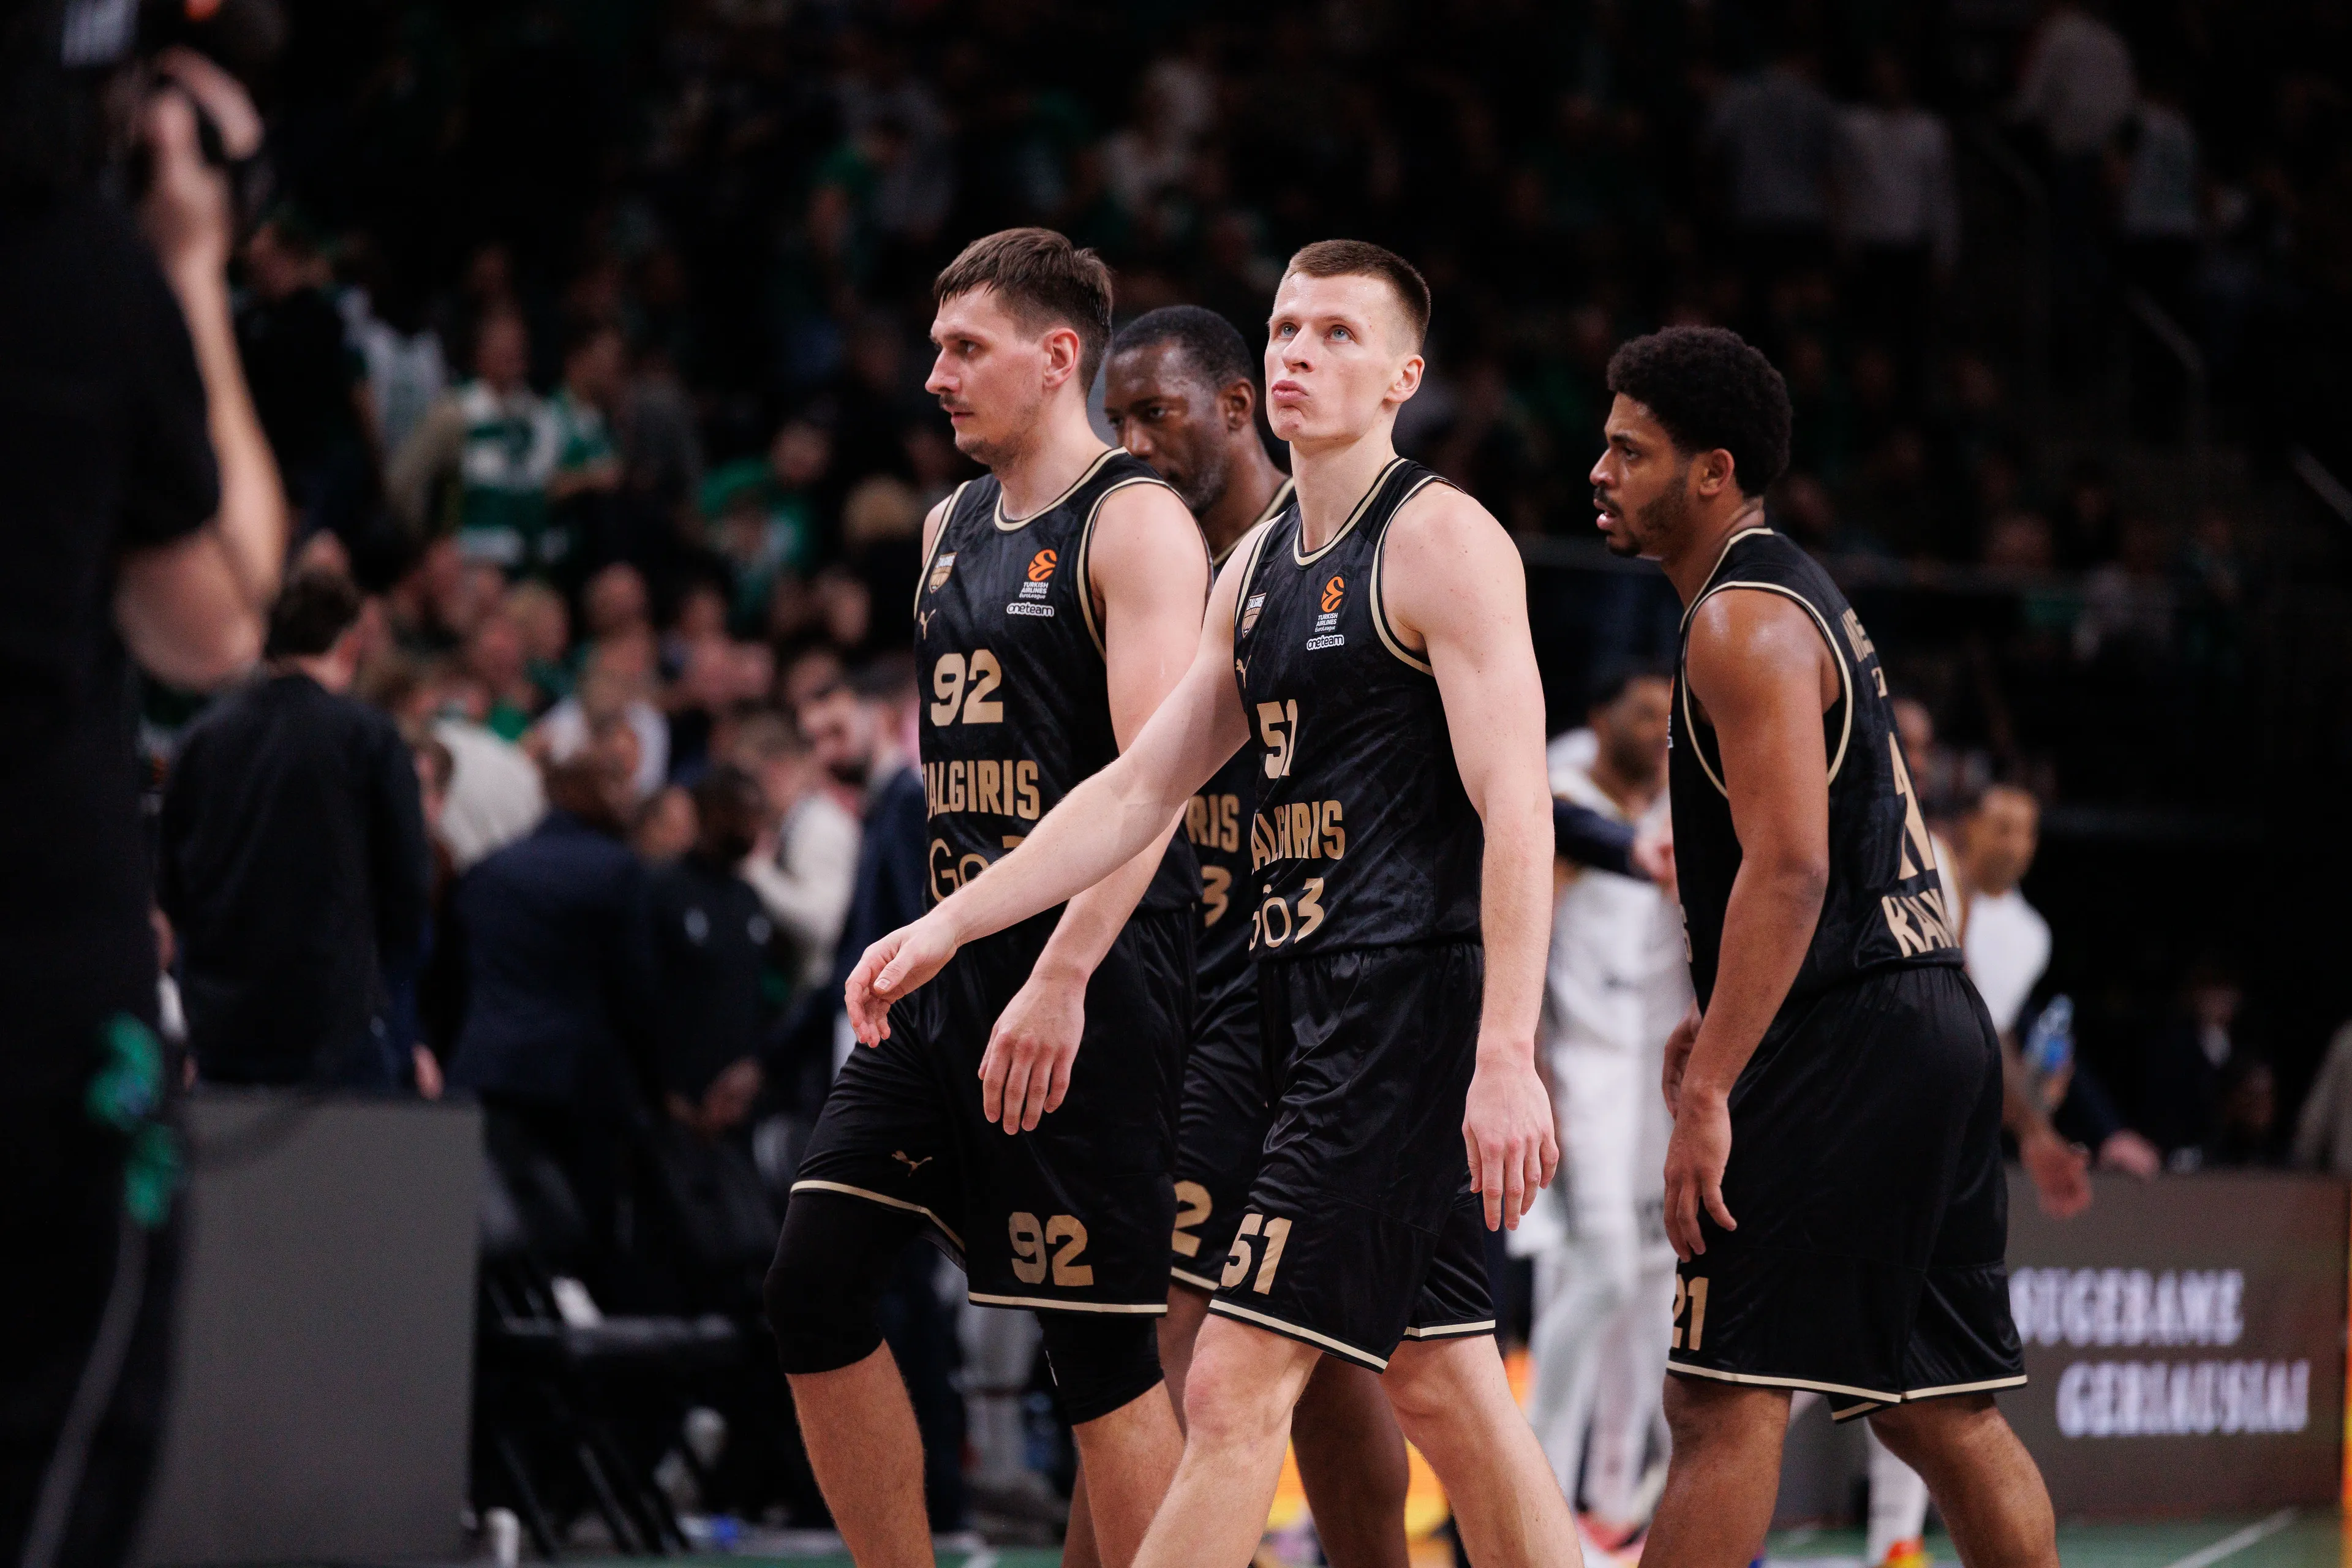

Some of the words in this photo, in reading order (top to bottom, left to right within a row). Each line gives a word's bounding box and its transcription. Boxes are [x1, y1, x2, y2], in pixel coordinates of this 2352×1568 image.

[1007, 602, 1055, 617] oneteam
[1306, 635, 1344, 650] oneteam
[931, 649, 1003, 726] 92
[1257, 699, 1298, 778] 51
[1251, 800, 1346, 875] ALGIRIS
[1008, 1212, 1094, 1286] 92
[1221, 1213, 1292, 1295] 51
